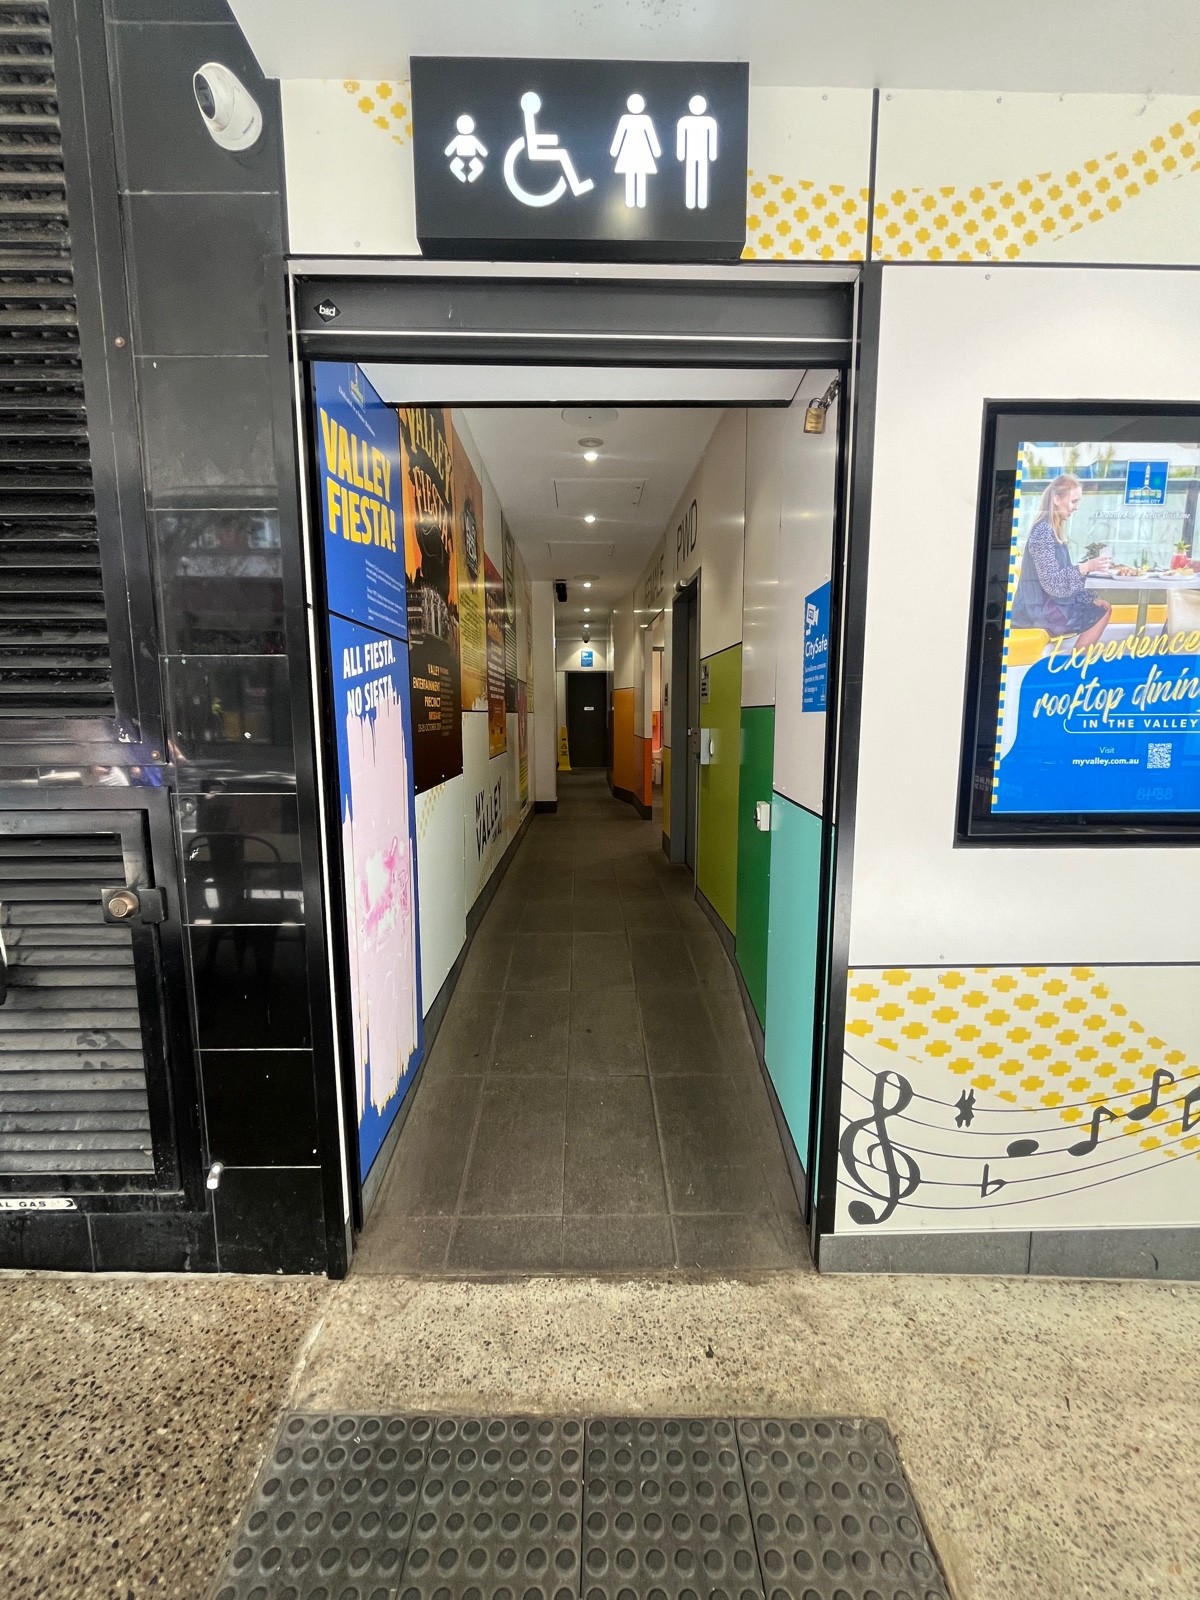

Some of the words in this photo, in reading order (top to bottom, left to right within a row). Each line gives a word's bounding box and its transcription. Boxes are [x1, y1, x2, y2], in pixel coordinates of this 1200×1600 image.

[319, 407, 391, 502] VALLEY
[404, 408, 453, 503] VALLEY
[326, 476, 397, 553] FIESTA!
[676, 499, 698, 571] PWD
[343, 645, 364, 679] ALL
[364, 639, 396, 672] FIESTA.
[805, 633, 828, 660] CitySafe
[1047, 626, 1200, 679] Experience
[346, 686, 362, 717] NO
[1032, 676, 1126, 724] rooftop
[1131, 664, 1200, 713] dinin
[1083, 719, 1098, 728] IN
[1108, 719, 1135, 728] THE
[1143, 718, 1200, 728] VALLEY
[1072, 757, 1140, 767] myvalley.com.au
[1099, 746, 1115, 754] Visit
[476, 775, 502, 862] VALLEY
